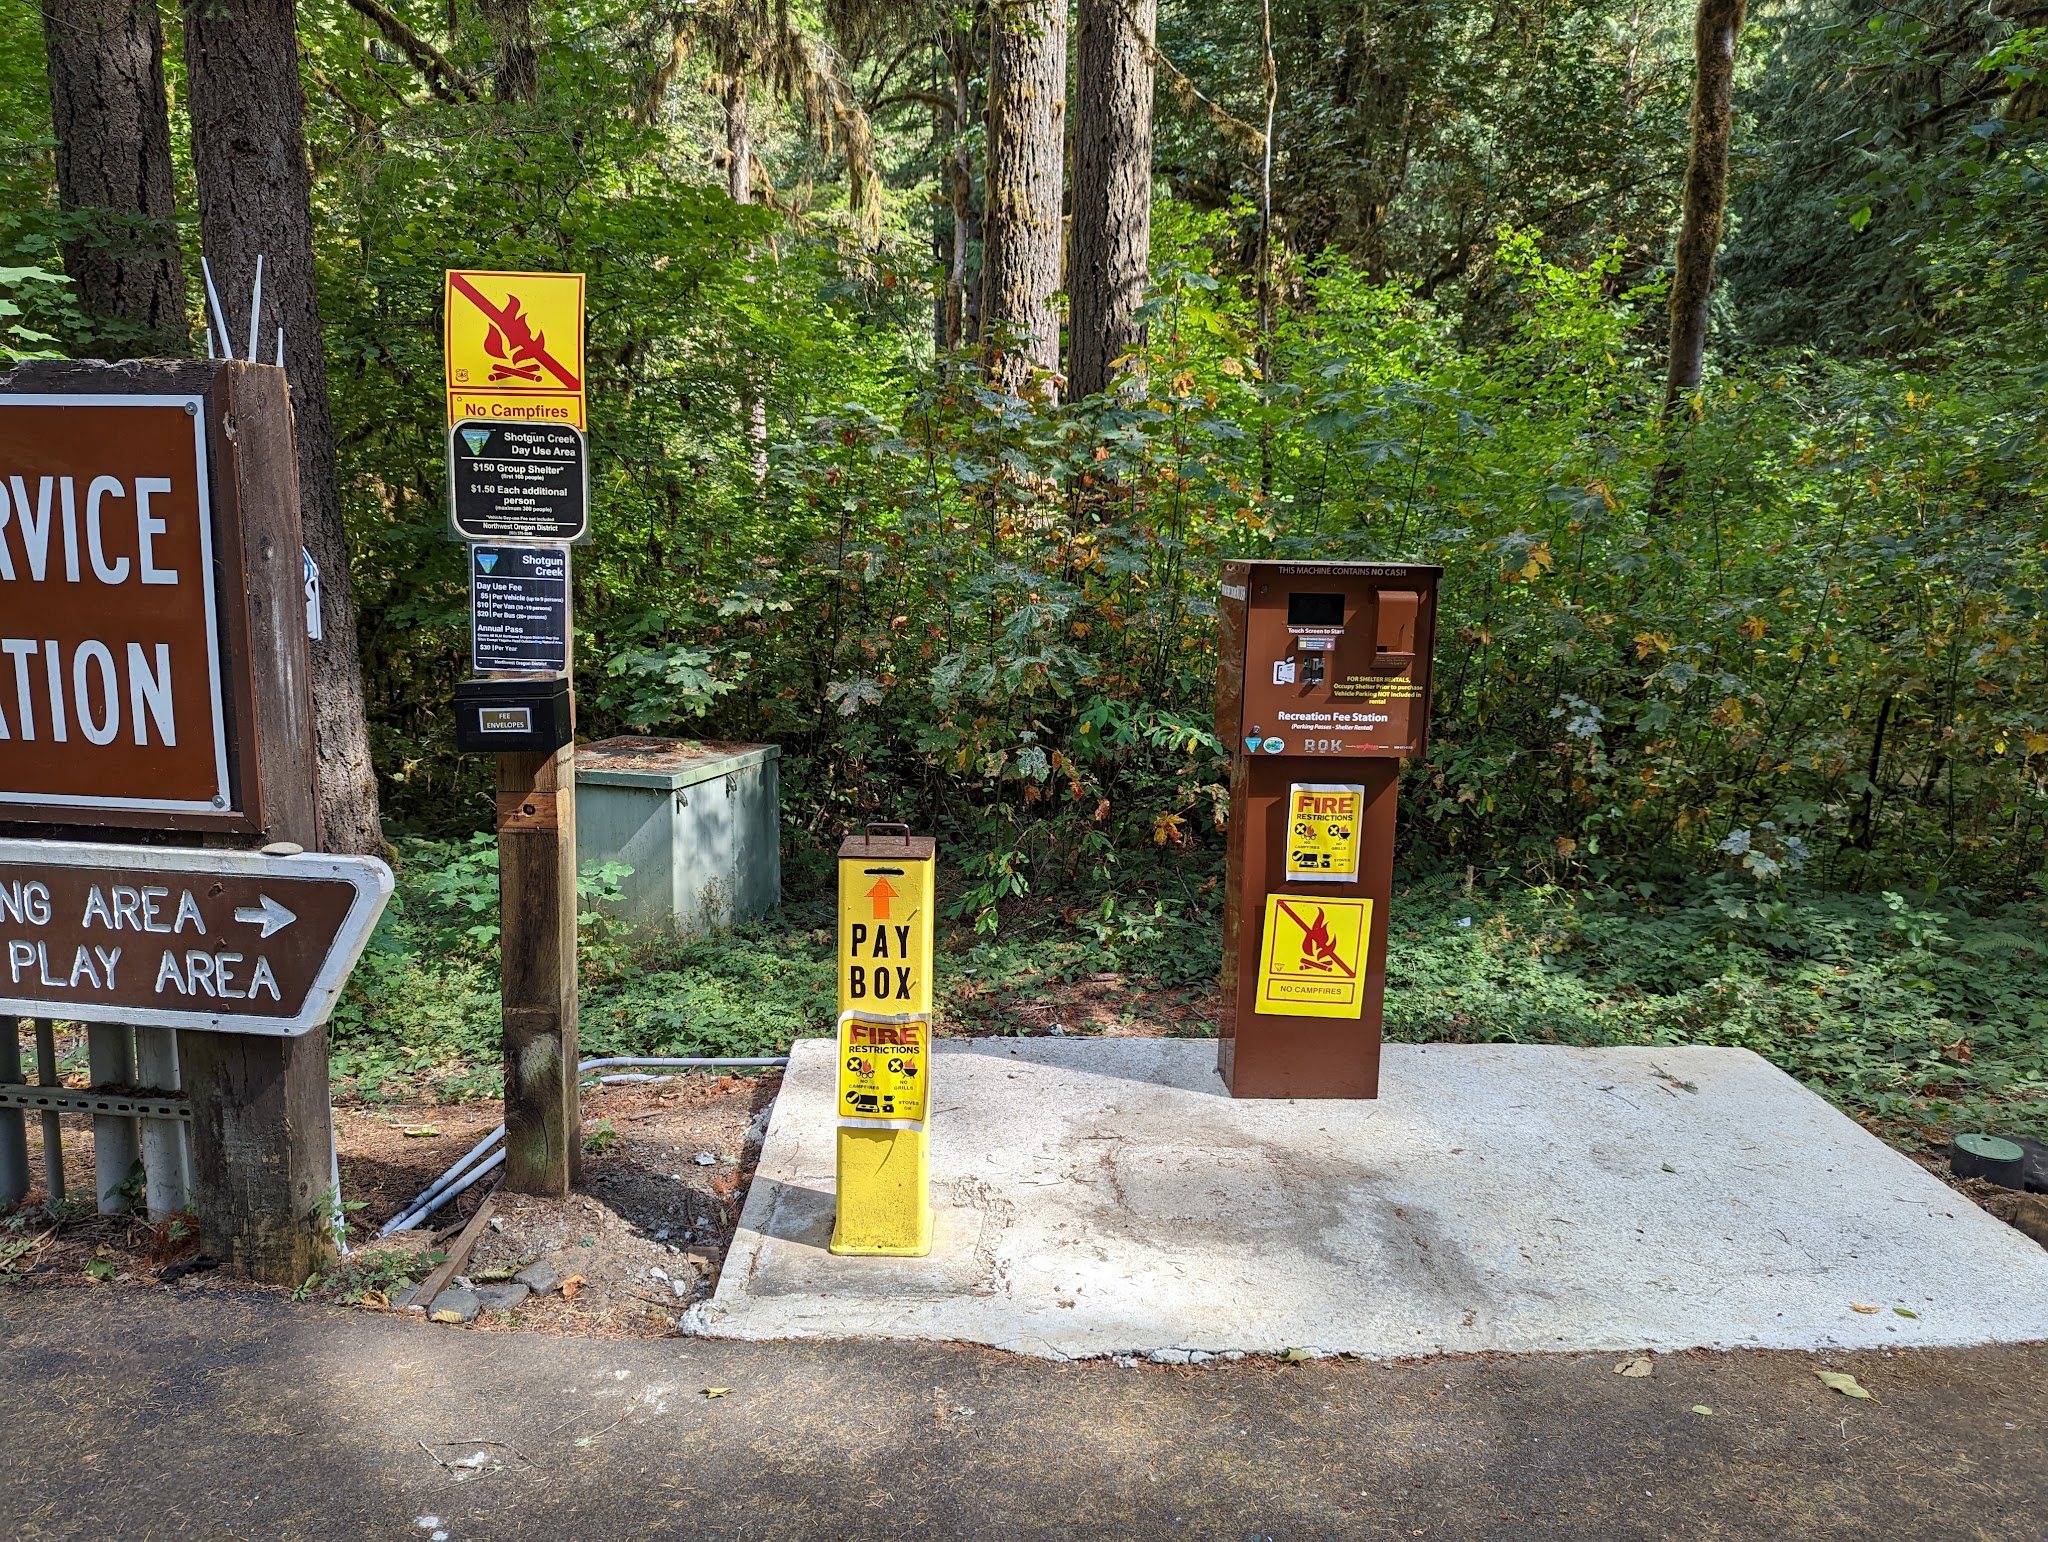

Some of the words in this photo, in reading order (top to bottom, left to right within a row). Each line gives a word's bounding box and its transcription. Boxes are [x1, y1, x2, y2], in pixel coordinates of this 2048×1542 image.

[465, 404, 486, 416] No
[491, 404, 569, 420] Campfires
[504, 432, 545, 444] Shotgun
[547, 433, 576, 444] Creek
[511, 446, 530, 456] Day
[532, 446, 551, 456] Use
[553, 447, 576, 456] Area
[473, 463, 495, 472] $150
[497, 464, 526, 474] Group
[471, 484, 495, 494] $1.50
[497, 486, 520, 494] Each
[522, 486, 568, 496] additional
[504, 497, 536, 506] person
[483, 522, 513, 530] Northwest
[513, 523, 536, 531] Oregon
[522, 555, 563, 566] Shotgun
[535, 567, 563, 576] Creek
[1296, 567, 1331, 575] MACHINE
[1332, 567, 1370, 575] CONTAINS
[1370, 568, 1384, 576] NO
[476, 582, 491, 591] Day
[492, 582, 507, 590] Use
[508, 583, 522, 591] Fee
[477, 624, 504, 632] Annual
[505, 625, 524, 633] Pass
[0, 639, 176, 747] TION
[1278, 711, 1331, 721] Recreation
[1333, 712, 1350, 721] Fee
[1352, 712, 1388, 722] Station
[1304, 739, 1342, 751] ROK
[1298, 796, 1353, 814] FIRE
[0, 879, 51, 925] NG
[82, 884, 206, 935] AREA
[851, 924, 910, 958] PAY
[9, 940, 121, 990] PLAY
[155, 950, 282, 1001] AREA
[850, 966, 911, 1000] BOX
[1280, 985, 1292, 993] NO
[1294, 986, 1342, 995] CAMPFIRES
[850, 1025, 919, 1045] FIRE
[849, 1046, 920, 1054] RESTRICTIONS
